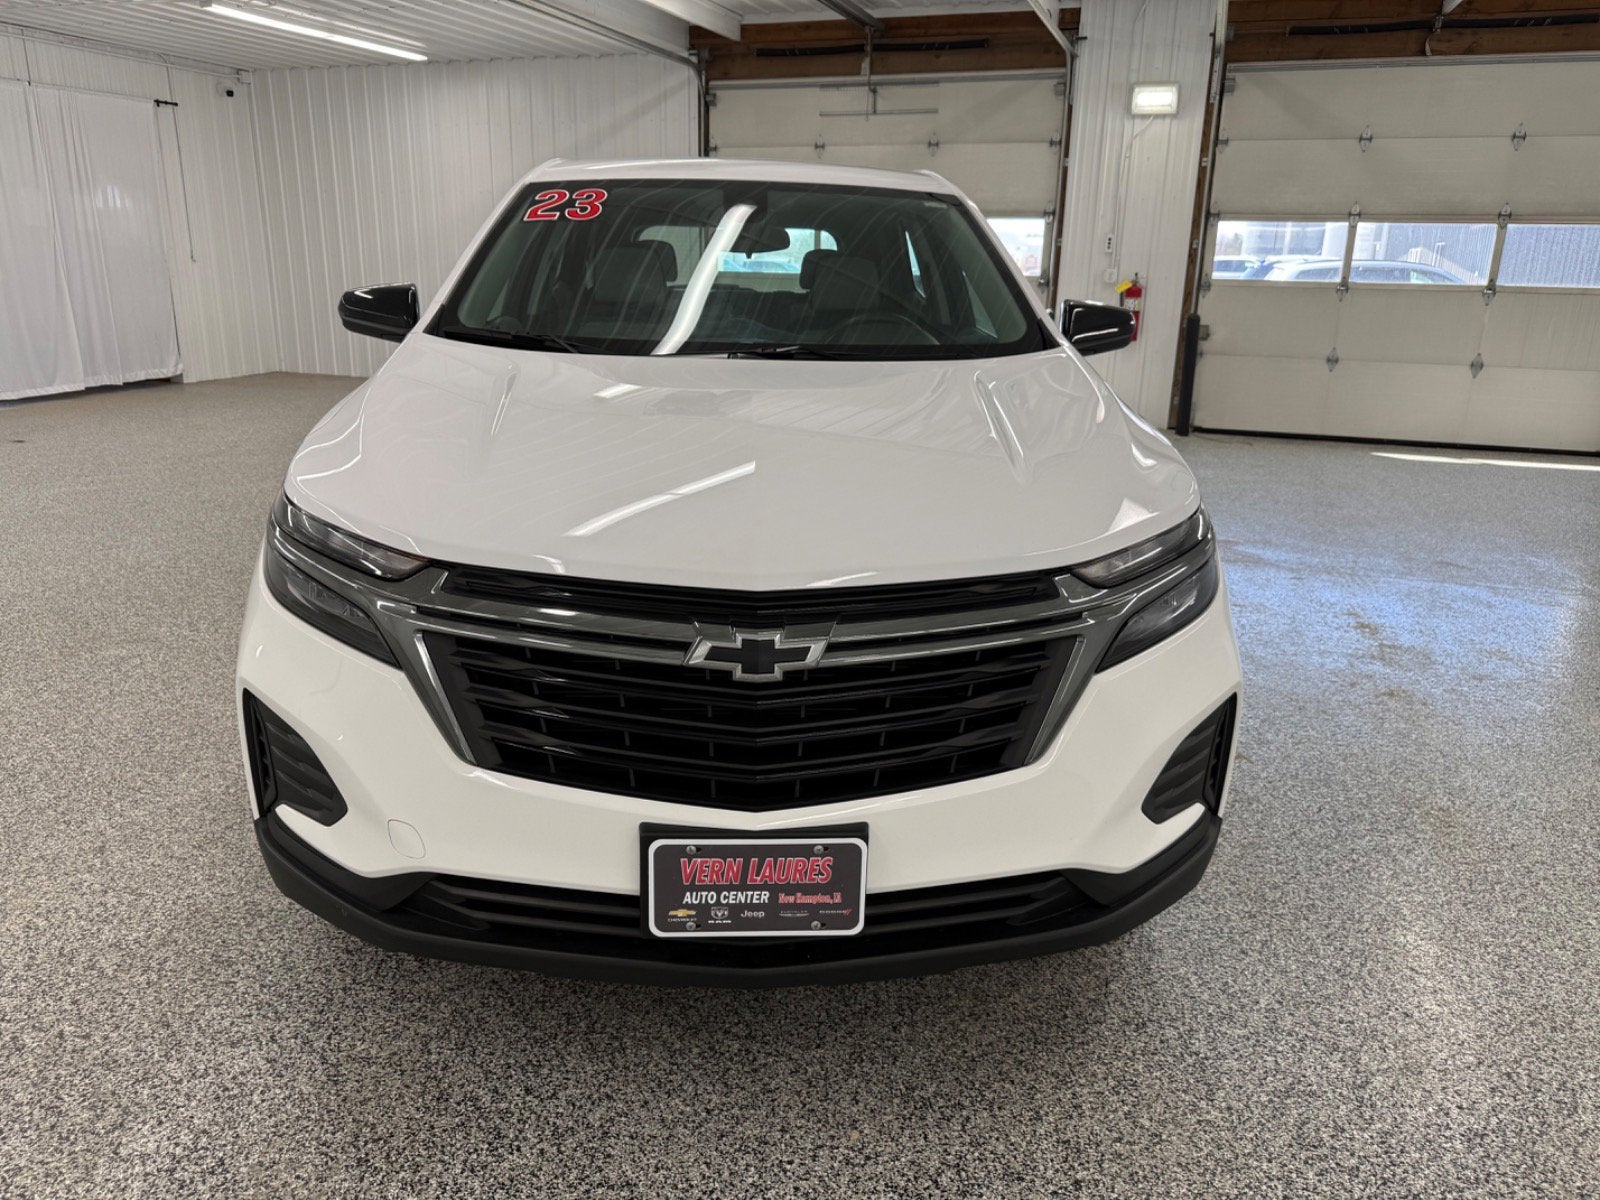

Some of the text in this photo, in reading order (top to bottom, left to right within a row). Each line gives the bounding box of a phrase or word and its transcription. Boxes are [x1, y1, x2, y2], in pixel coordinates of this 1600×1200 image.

[523, 188, 608, 222] 23
[680, 857, 833, 885] VERN LAURES
[682, 891, 769, 904] AUTO CENTER
[778, 893, 795, 904] New
[740, 910, 765, 919] Jeep
